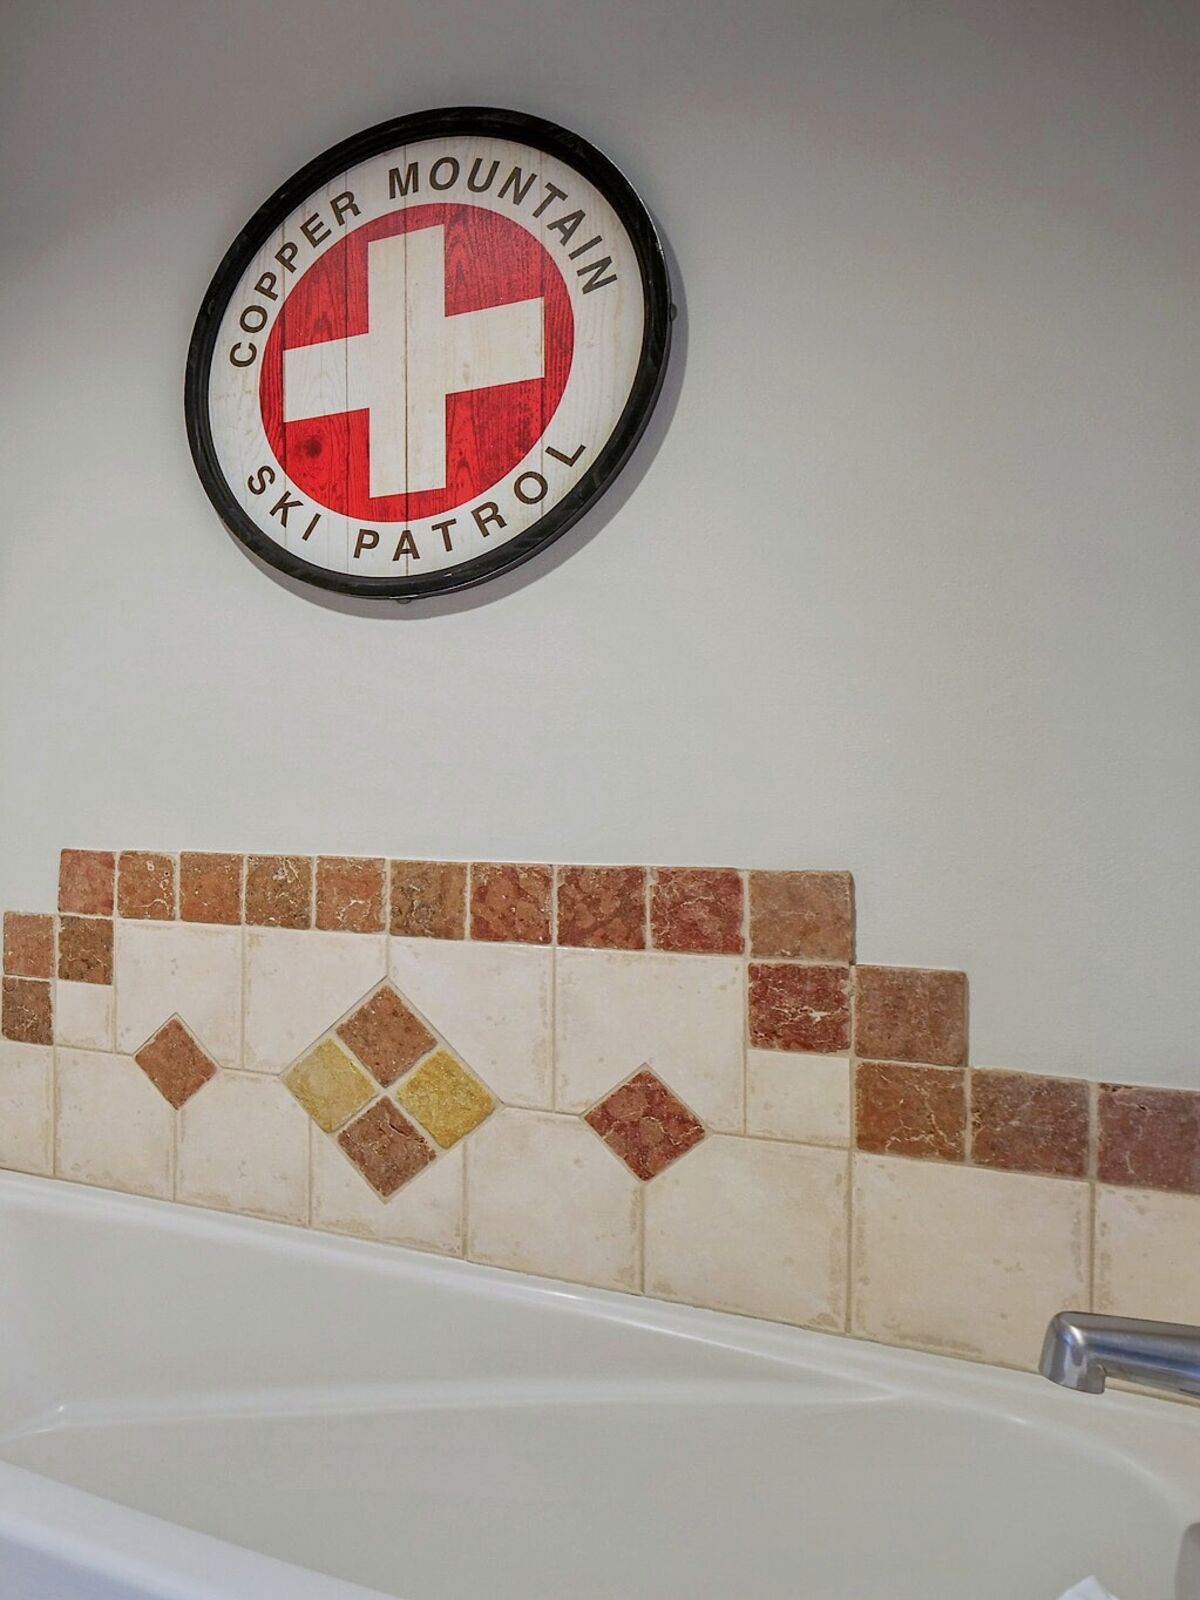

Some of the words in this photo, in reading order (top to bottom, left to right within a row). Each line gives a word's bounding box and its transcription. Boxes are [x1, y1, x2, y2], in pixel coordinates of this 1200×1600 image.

[229, 190, 362, 368] COPPER
[388, 156, 618, 295] MOUNTAIN
[247, 465, 321, 541] SKI
[353, 441, 586, 562] PATROL
